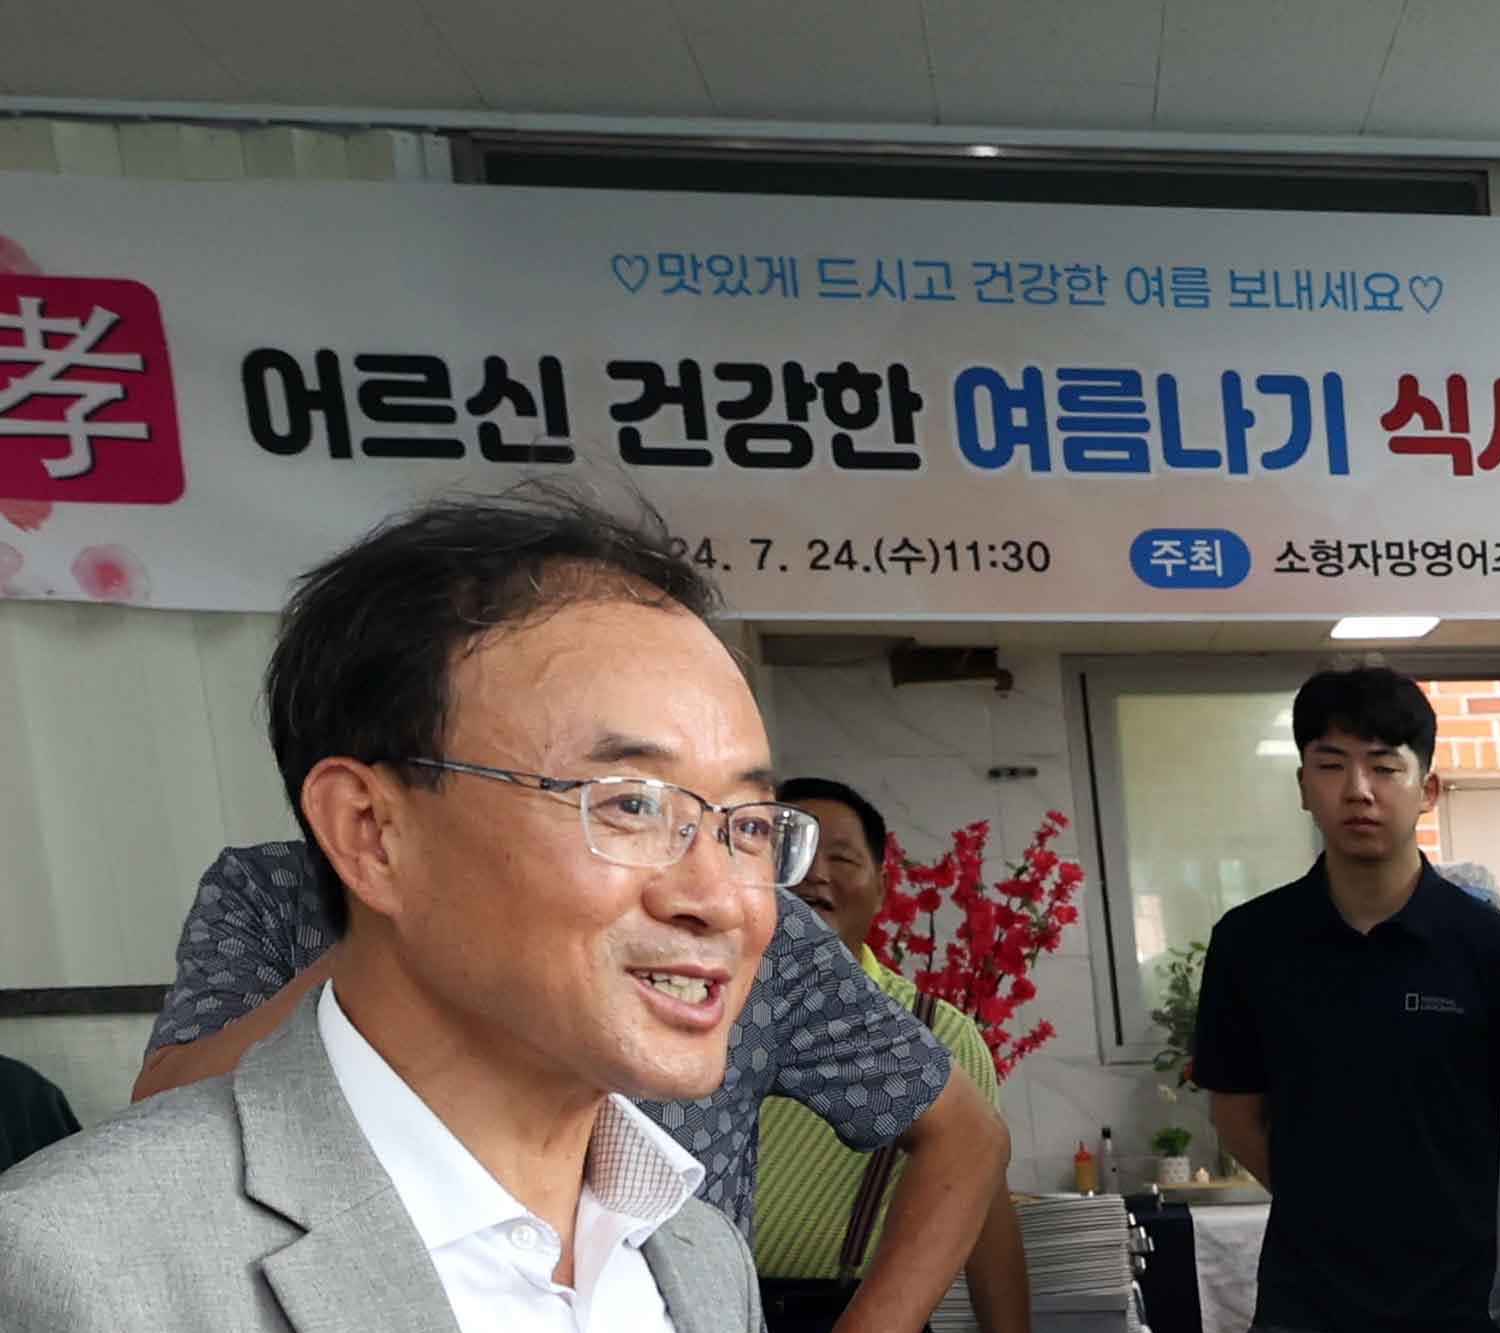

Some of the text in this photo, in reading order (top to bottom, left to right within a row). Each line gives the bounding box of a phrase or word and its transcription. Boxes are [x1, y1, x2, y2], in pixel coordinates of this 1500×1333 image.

[659, 253, 1404, 314] 맛있게 드시고 건강한 여름 보내세요
[0, 297, 150, 478] 孝
[242, 346, 575, 464] 어르신
[607, 359, 923, 470] 건강한
[954, 364, 1351, 477] 여름나기
[1149, 538, 1224, 578] 주최
